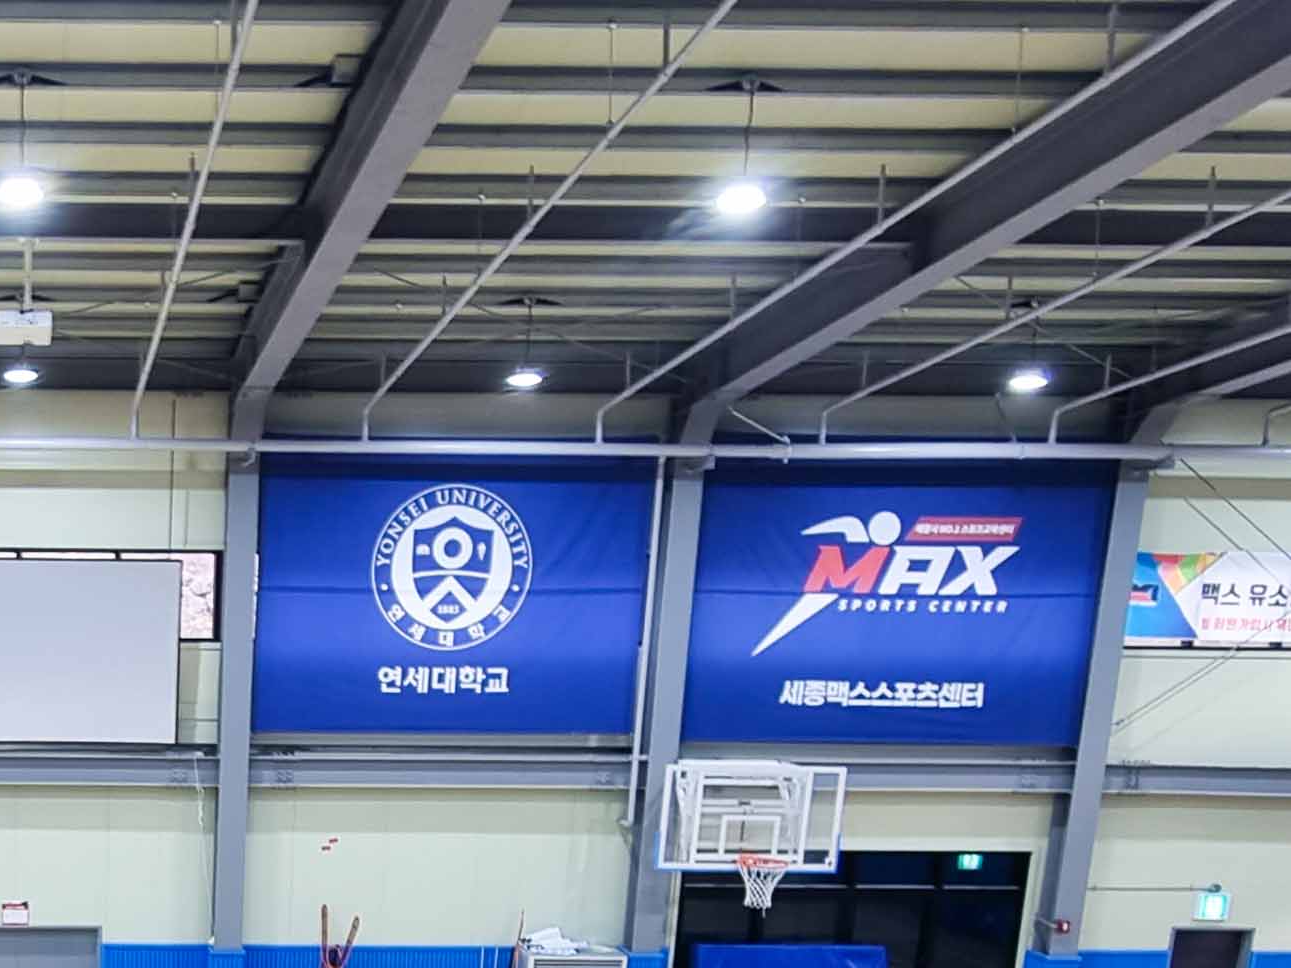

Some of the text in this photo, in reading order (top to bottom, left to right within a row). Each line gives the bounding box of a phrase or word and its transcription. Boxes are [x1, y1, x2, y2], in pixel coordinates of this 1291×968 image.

[376, 489, 528, 569] YONSEI UNIVERSITY
[804, 545, 1020, 596] MAX
[838, 599, 1008, 613] SPORTS CENTER
[1201, 583, 1291, 607] 맥스 유소
[378, 666, 509, 694] 연세대학교
[779, 680, 984, 708] 세종맥스스포츠센터
